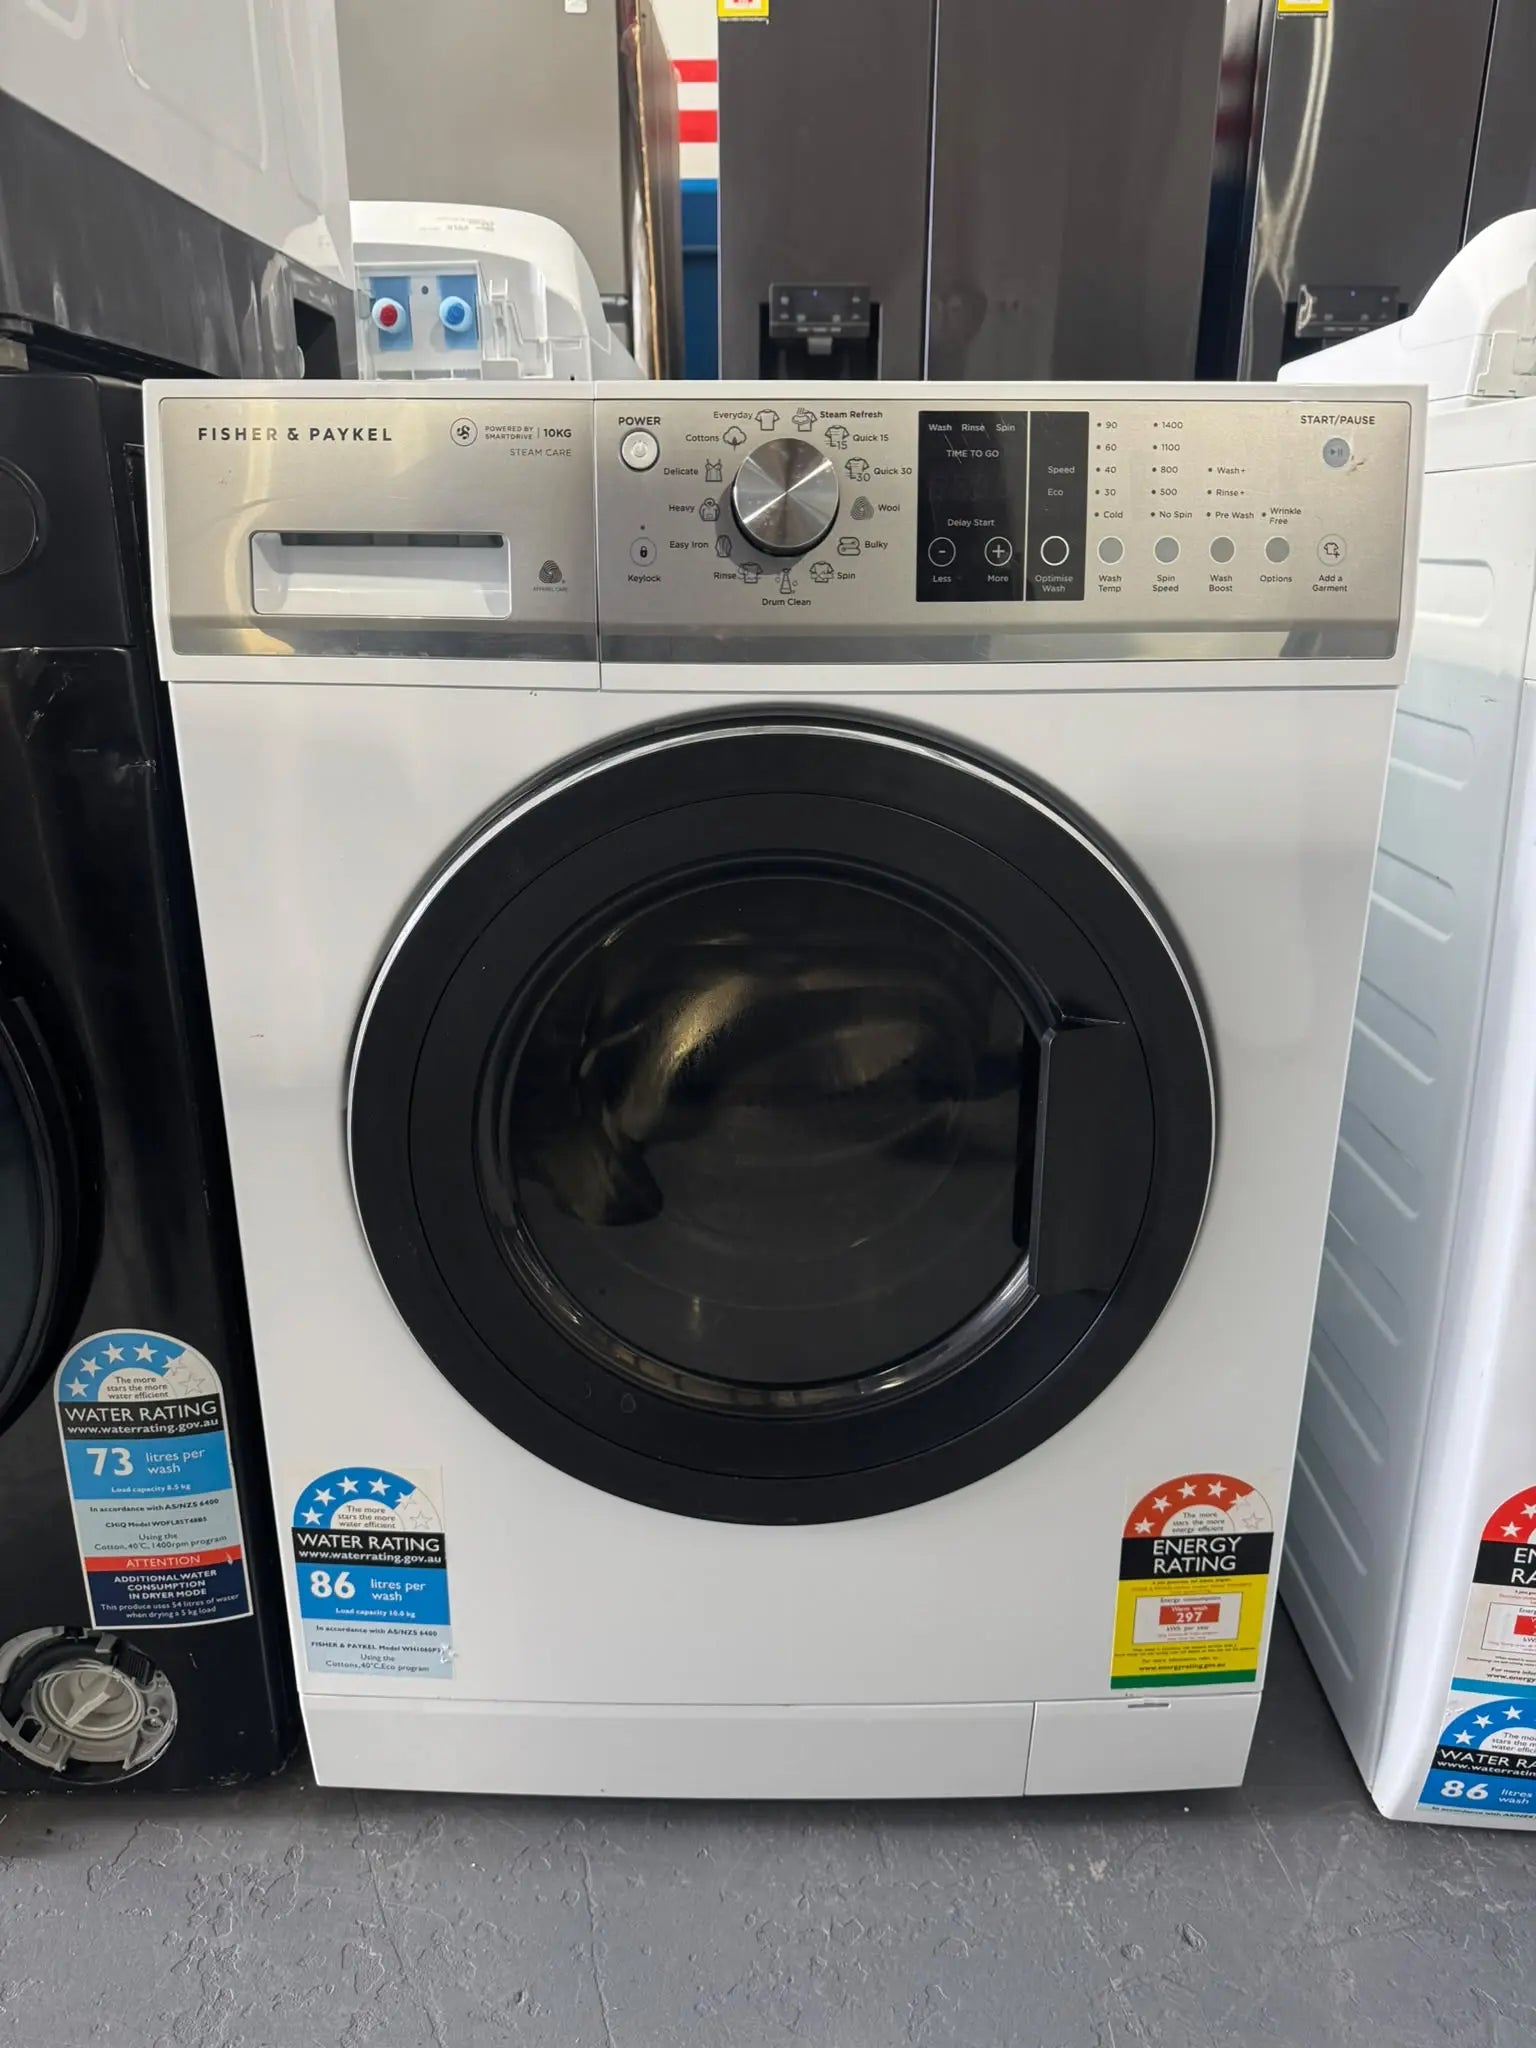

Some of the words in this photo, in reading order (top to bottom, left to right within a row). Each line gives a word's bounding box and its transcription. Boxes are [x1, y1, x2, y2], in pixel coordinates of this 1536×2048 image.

[713, 411, 753, 421] Everyday
[820, 411, 848, 419] Steam
[850, 411, 883, 419] Refresh
[618, 416, 661, 427] POWER
[1106, 421, 1118, 429] 90
[1162, 421, 1183, 429] 1400
[1300, 415, 1376, 426] START/PAUSE
[928, 424, 952, 432] Wash
[962, 424, 985, 432] Rinse
[996, 424, 1016, 433] Spin
[198, 427, 279, 441] FISHER
[287, 427, 300, 441] &
[309, 427, 392, 441] PAYKEL
[544, 428, 573, 438] 10KG
[686, 434, 720, 442] Cottons
[852, 434, 877, 443] Quick
[880, 434, 889, 442] 15
[836, 440, 848, 450] 15
[1105, 444, 1117, 452] 60
[1161, 444, 1181, 452] 1100
[510, 449, 543, 457] STEAM
[544, 449, 573, 457] CARE
[946, 450, 968, 458] TIME
[970, 450, 983, 458] TO
[985, 450, 1000, 458] GO
[664, 467, 699, 476] Delicate
[873, 467, 896, 477] Quick
[897, 467, 913, 476] 30
[1048, 466, 1075, 475] Speed
[1104, 466, 1117, 474] 40
[1160, 466, 1179, 474] 800
[856, 472, 871, 482] 30
[1104, 488, 1117, 496] 30
[1160, 488, 1178, 496] 500
[668, 504, 695, 514] Heavy
[878, 504, 900, 512] Wool
[1270, 507, 1302, 516] Wrinkle
[1104, 511, 1124, 519] Cold
[1160, 511, 1173, 519] No
[1174, 511, 1193, 521] Spin
[1215, 511, 1230, 519] Pre
[1231, 511, 1255, 519] Wash
[947, 519, 972, 528] Delay
[974, 519, 995, 527] Start
[1269, 517, 1288, 526] Free
[670, 541, 690, 550] Easy
[692, 541, 709, 549] Iron
[865, 541, 888, 550] Bulky
[628, 574, 661, 584] Keylock
[714, 572, 737, 580] Rinse
[837, 572, 856, 581] Spin
[933, 575, 952, 583] Less
[988, 575, 1009, 583] More
[1035, 575, 1074, 584] Optimise
[1098, 575, 1122, 583] Wash
[1157, 575, 1176, 585] Spin
[1210, 575, 1233, 583] Wash
[1260, 575, 1293, 585] Options
[1318, 575, 1336, 583] Add
[1042, 585, 1066, 593] Wash
[1098, 585, 1122, 594] Temp
[1153, 584, 1179, 594] Speed
[1209, 585, 1233, 593] Boost
[1312, 585, 1348, 593] Garment
[762, 598, 784, 606] Drum
[786, 598, 812, 606] Clean
[115, 1376, 131, 1384] The
[129, 1384, 143, 1392] the
[134, 1391, 169, 1399] efficient
[65, 1407, 134, 1422] WATER
[140, 1400, 217, 1421] RATING
[67, 1418, 219, 1434] www.waterrating.gov.au
[146, 1452, 179, 1463] litres
[184, 1449, 206, 1464] per
[86, 1447, 134, 1477] 73
[148, 1463, 181, 1475] wash
[133, 1486, 166, 1494] capacity
[347, 1505, 362, 1513] The
[364, 1521, 396, 1529] efficient
[191, 1535, 227, 1547] program
[297, 1533, 364, 1550] WATER
[368, 1536, 440, 1552] RATING
[1153, 1536, 1243, 1556] ENERGY
[126, 1555, 201, 1569] ATTENTION
[298, 1550, 442, 1565] www.waterrating.gov.au
[1153, 1555, 1237, 1574] RATING
[114, 1574, 180, 1583] ADDITIONAL
[180, 1570, 217, 1580] WATER
[128, 1580, 206, 1592] CONSUMPTION
[310, 1570, 356, 1599] 86
[370, 1579, 402, 1590] litres
[405, 1581, 426, 1593] per
[142, 1591, 174, 1600] DRYER
[176, 1588, 207, 1598] MODE
[372, 1592, 403, 1601] wash
[119, 1602, 152, 1612] produce
[172, 1601, 183, 1609] 54
[184, 1599, 204, 1607] litres
[216, 1594, 240, 1603] water
[149, 1610, 174, 1620] drying
[188, 1609, 198, 1617] kg
[199, 1606, 216, 1614] load
[356, 1609, 387, 1617] capacity
[406, 1611, 416, 1619] kg
[1176, 1611, 1203, 1623] 297
[360, 1654, 381, 1662] Using
[1504, 1732, 1519, 1740] The
[1441, 1749, 1510, 1767] WATER
[1440, 1780, 1489, 1801] 86
[1501, 1788, 1533, 1798] litres
[1498, 1797, 1530, 1805] wash
